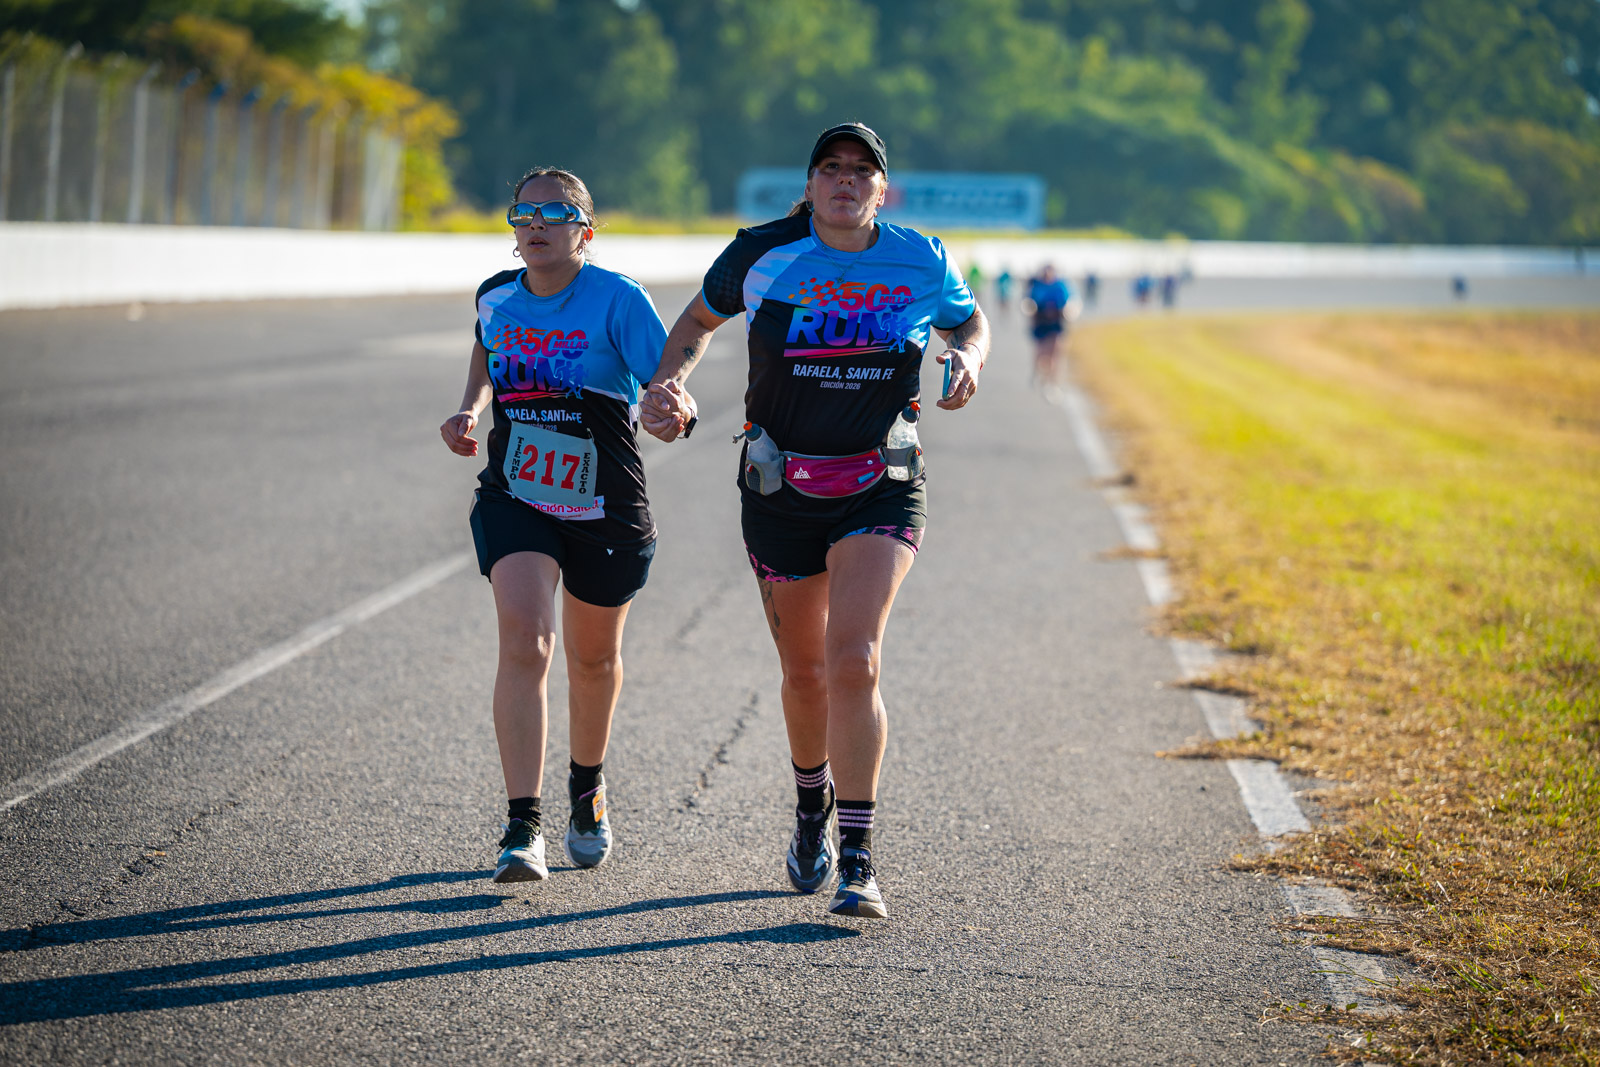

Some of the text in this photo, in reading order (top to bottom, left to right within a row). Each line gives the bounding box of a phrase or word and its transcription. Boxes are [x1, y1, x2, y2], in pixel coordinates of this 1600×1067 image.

[880, 296, 916, 305] MILLAS
[553, 341, 589, 349] MILLAS
[785, 307, 894, 346] RUN
[488, 353, 566, 391] RUN
[793, 364, 895, 380] RAFAELA, SANTA FE
[820, 381, 861, 390] EDICIÓN 2026
[509, 436, 524, 480] TIEMPO
[518, 444, 580, 490] 217
[579, 453, 591, 494] EXACTO
